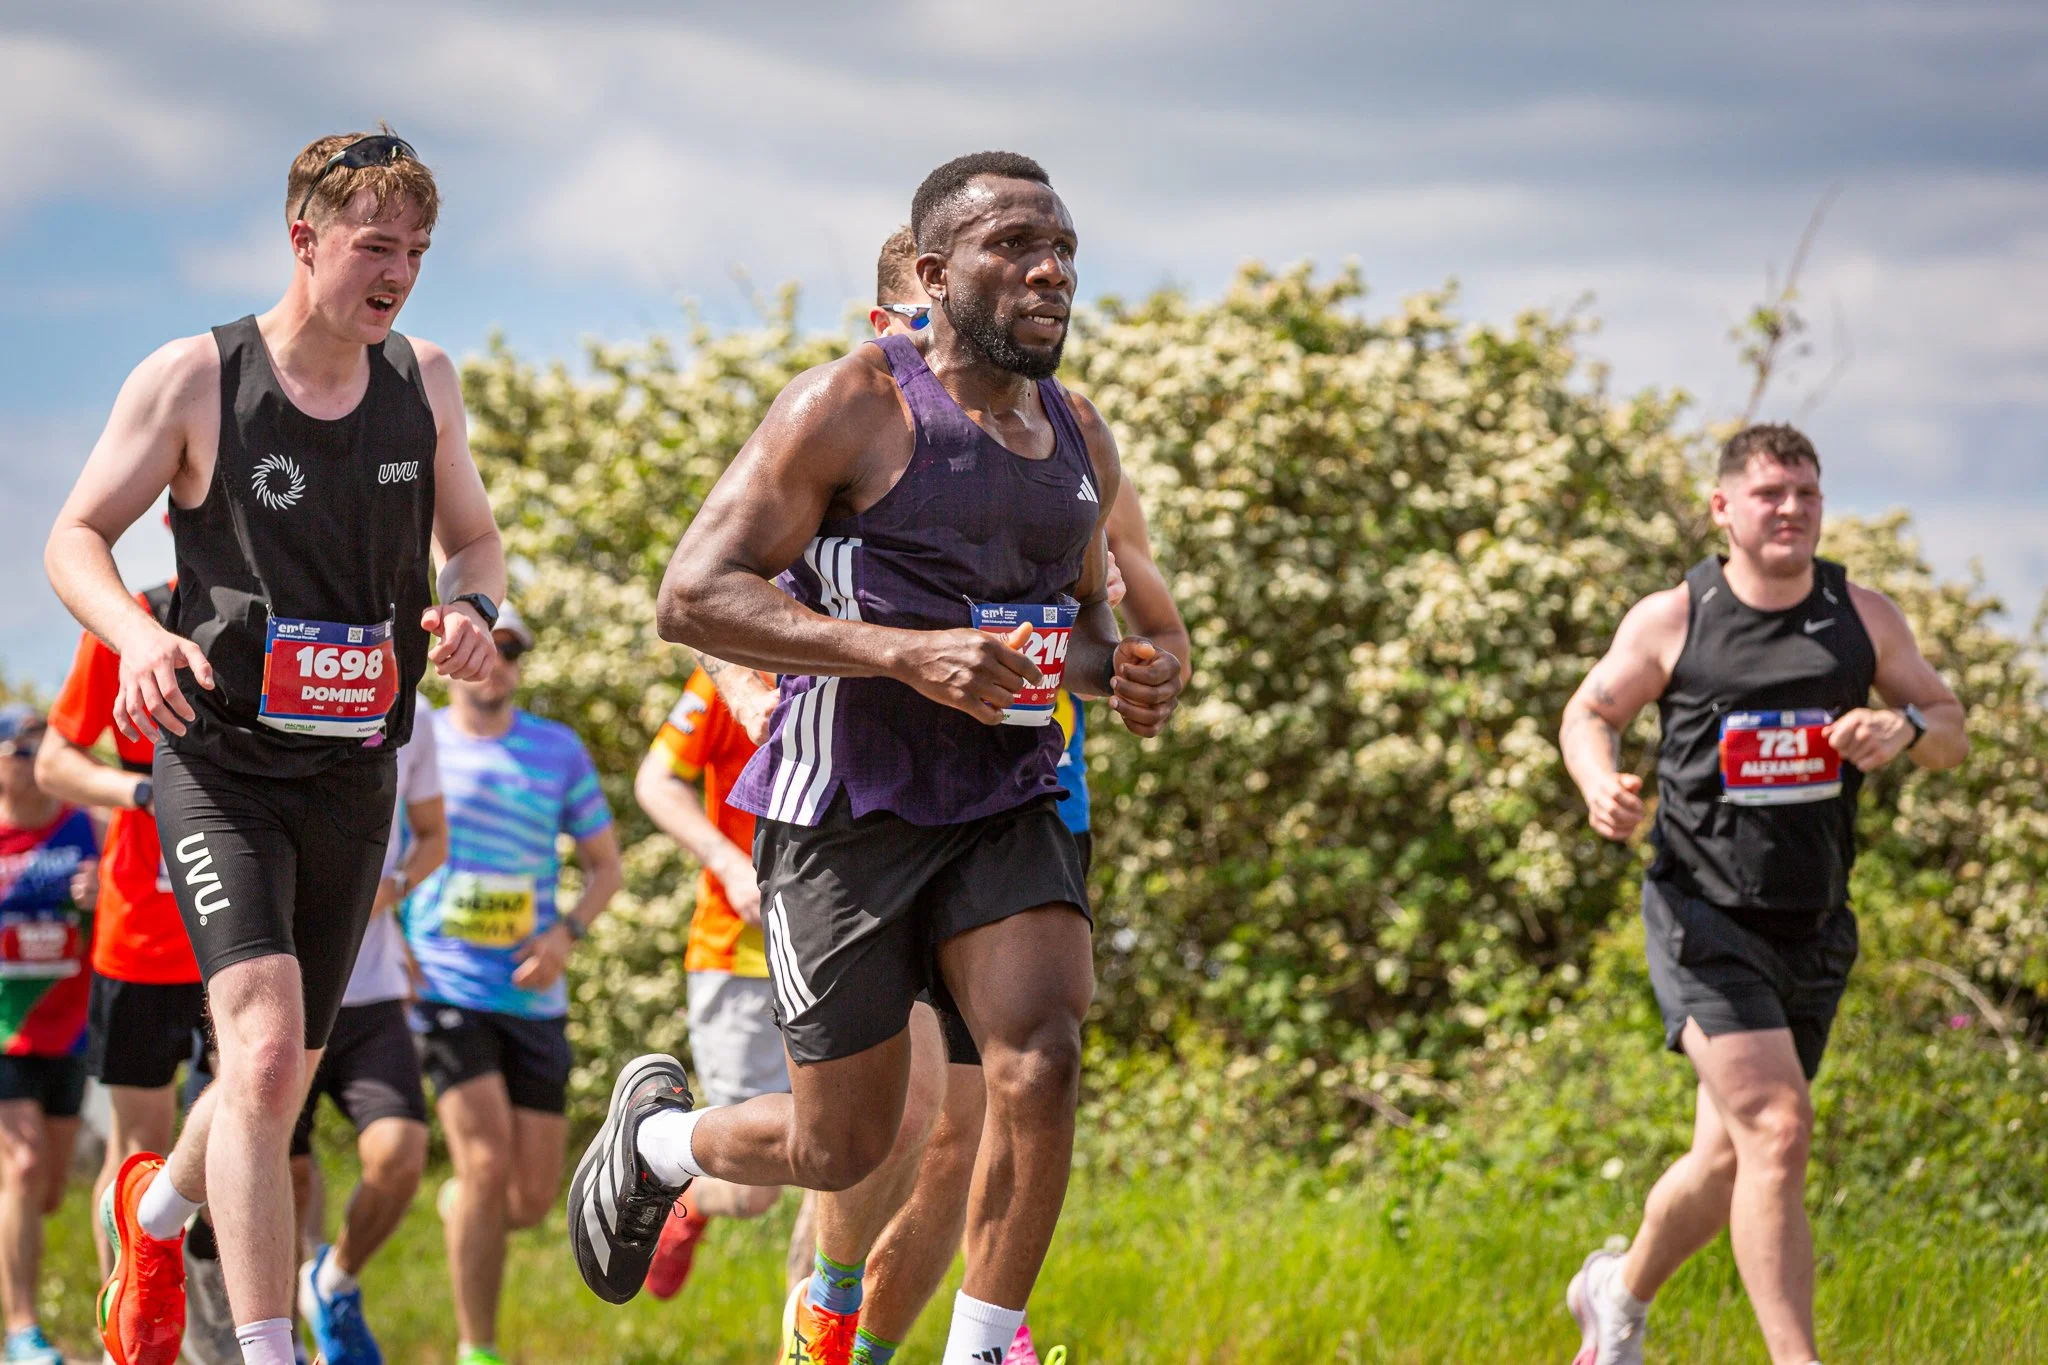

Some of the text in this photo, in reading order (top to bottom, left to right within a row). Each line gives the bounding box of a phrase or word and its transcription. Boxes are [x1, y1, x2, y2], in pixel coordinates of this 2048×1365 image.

[378, 461, 418, 484] UVU
[278, 623, 305, 634] emf
[1018, 631, 1069, 664] 214
[297, 646, 383, 680] 1698
[301, 685, 376, 703] DOMINIC
[1757, 728, 1808, 758] 721
[176, 831, 231, 915] UVU
